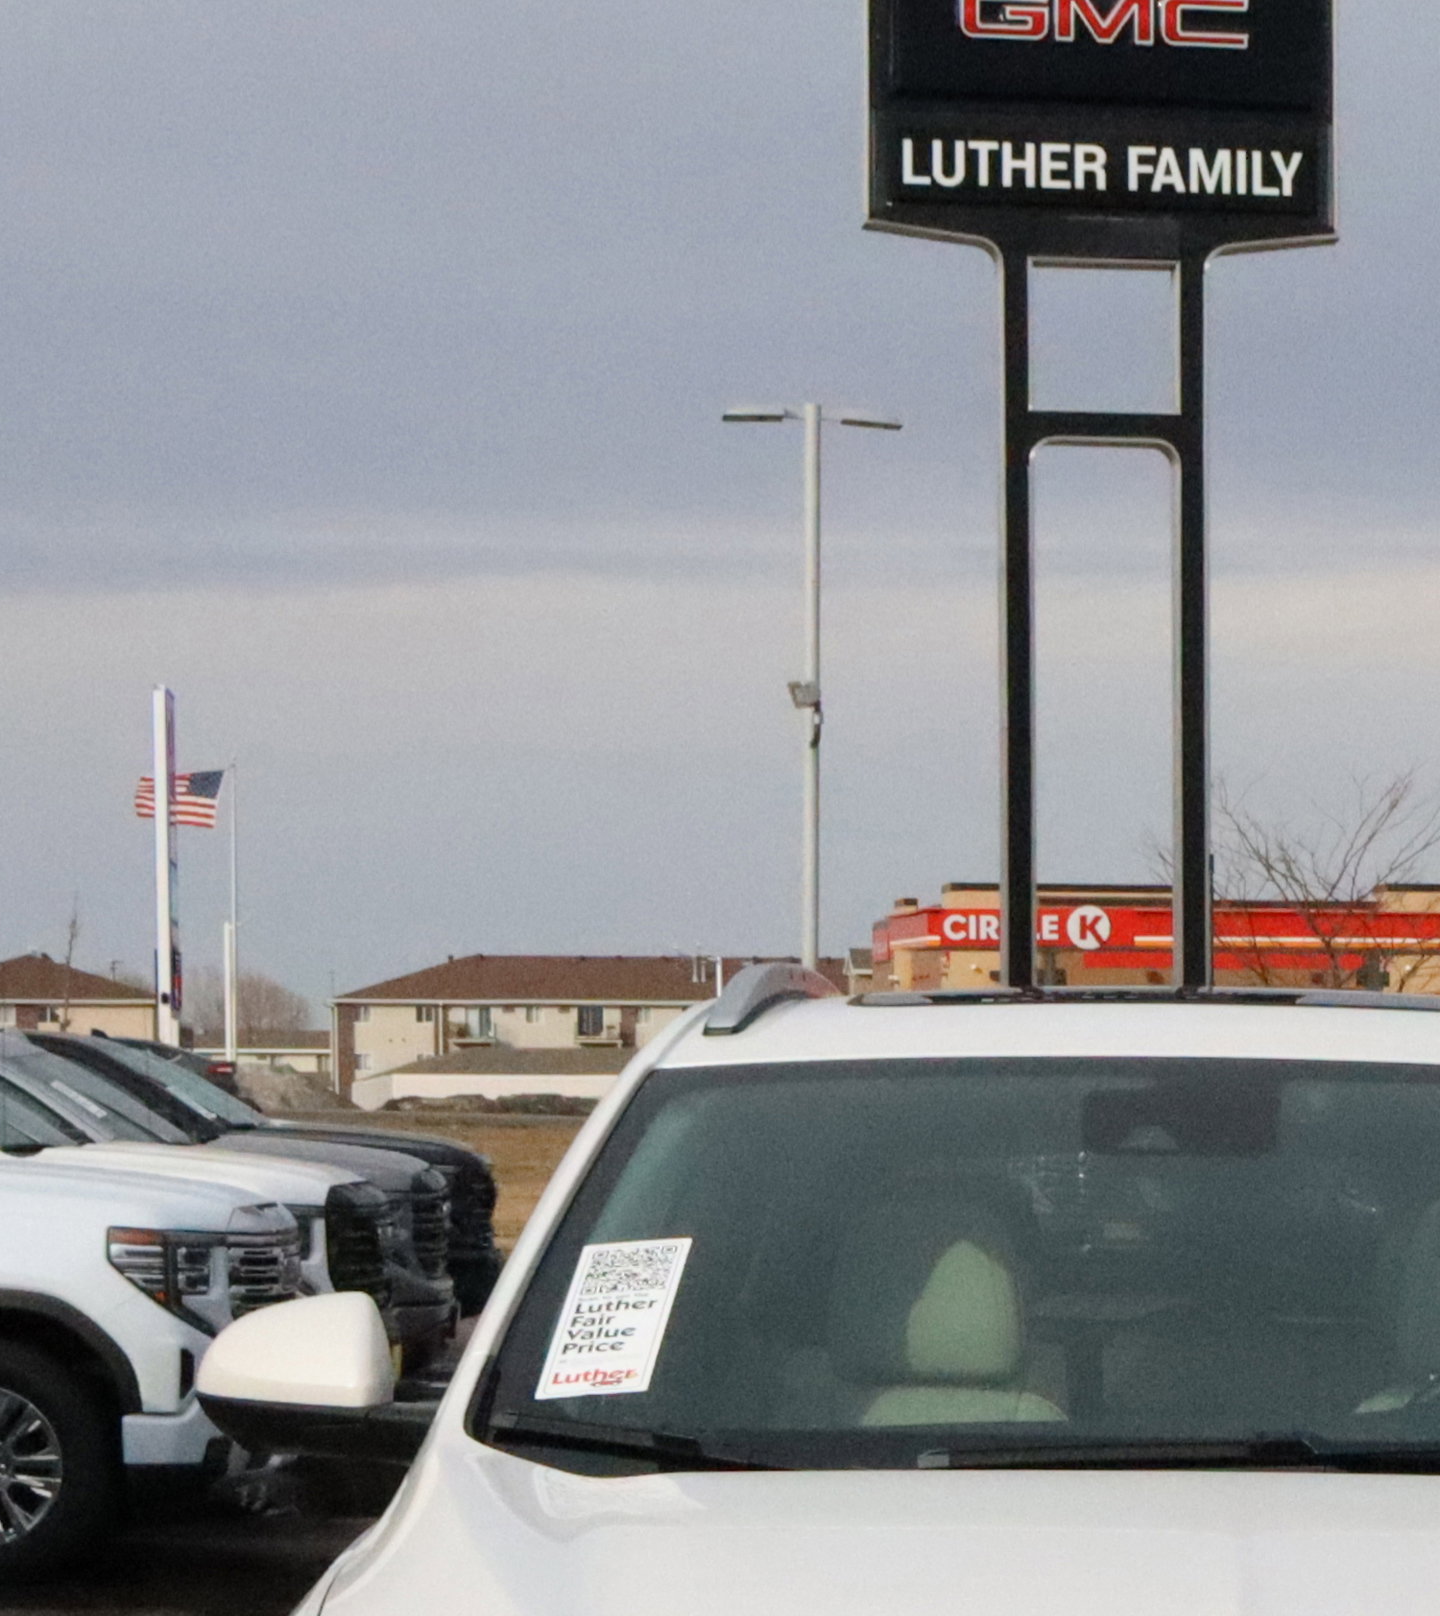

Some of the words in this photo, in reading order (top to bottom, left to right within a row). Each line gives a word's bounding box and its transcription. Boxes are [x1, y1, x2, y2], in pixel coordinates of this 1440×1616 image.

[960, 0, 1249, 49] GMC
[901, 138, 1107, 191] LUTHER
[1127, 146, 1303, 197] FAMILY
[943, 914, 1059, 940] CIRE
[1079, 914, 1105, 948] K
[575, 1299, 658, 1314] Luther
[571, 1314, 615, 1328] Fair
[567, 1326, 636, 1340] Value
[562, 1340, 625, 1355] Price
[552, 1368, 636, 1384] Luther
